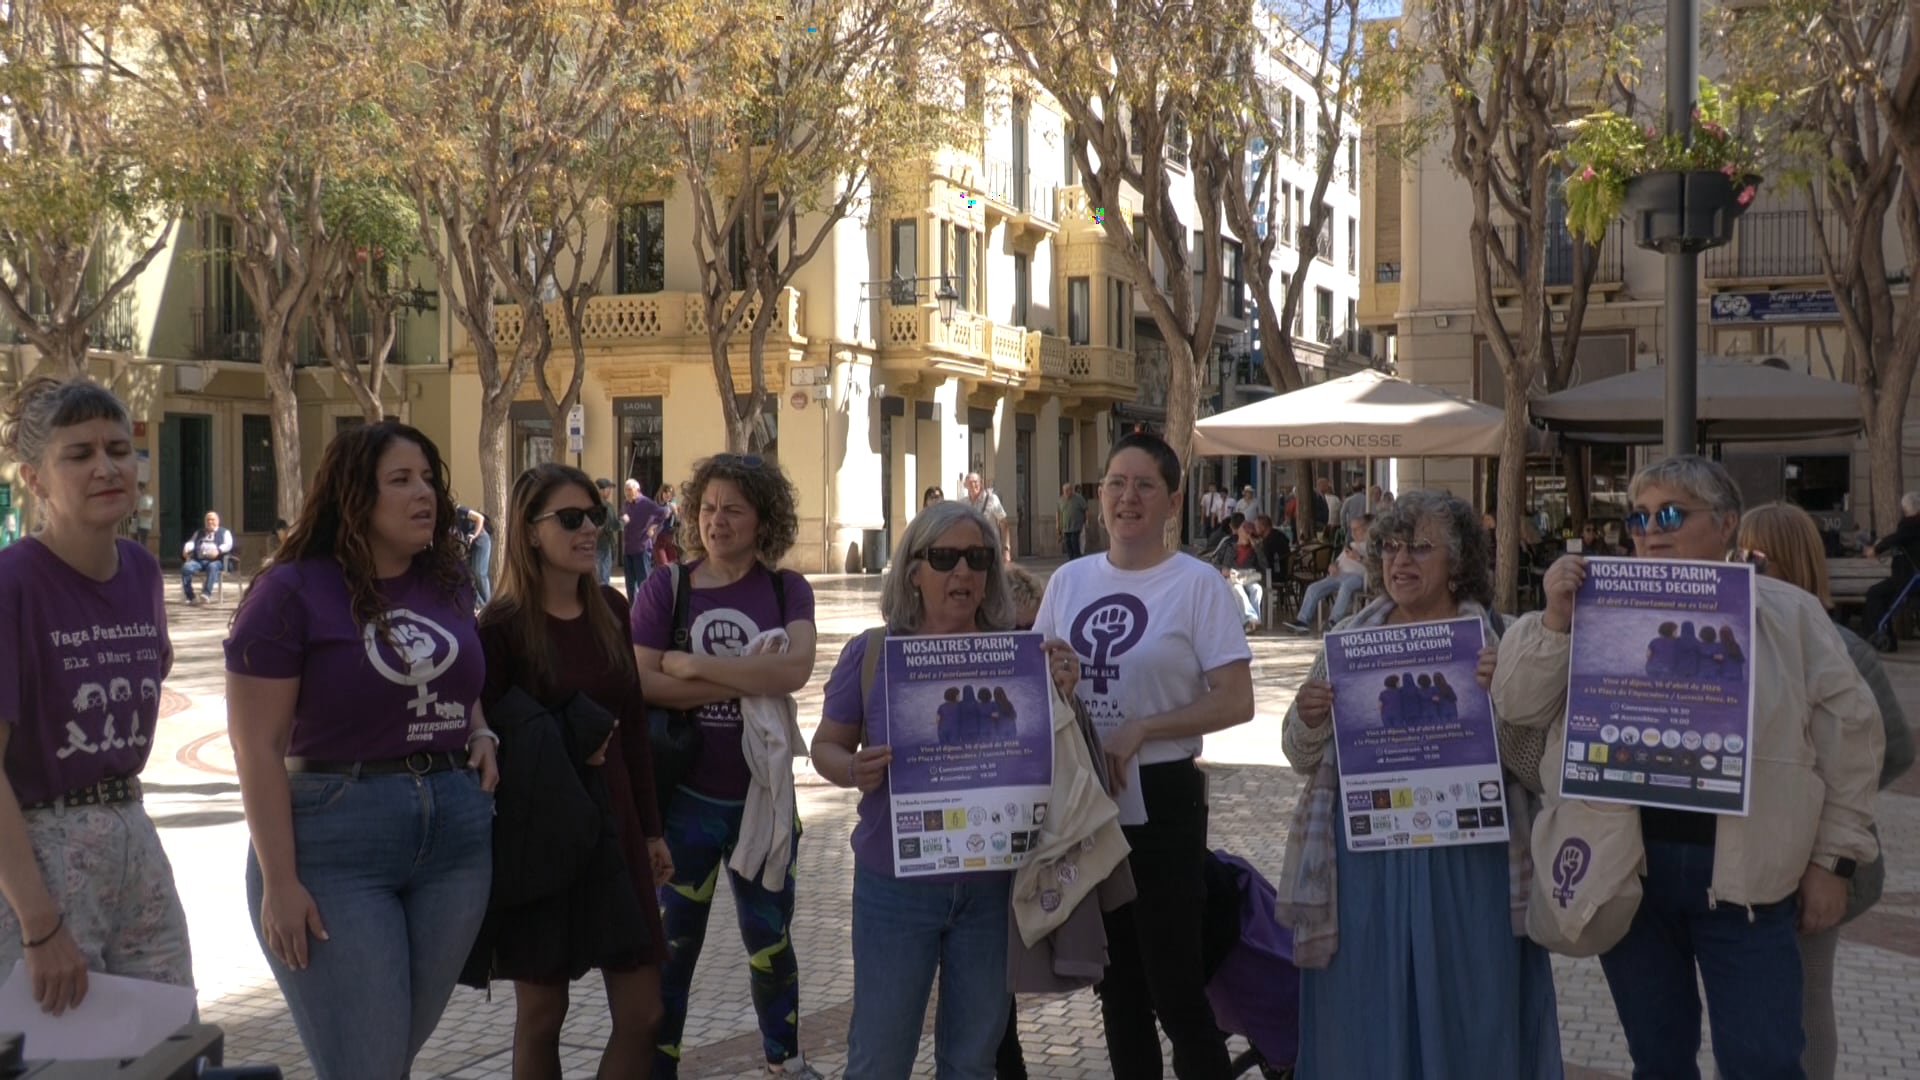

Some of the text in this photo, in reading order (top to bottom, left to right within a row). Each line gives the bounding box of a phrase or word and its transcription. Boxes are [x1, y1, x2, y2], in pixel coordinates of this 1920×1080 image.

[1278, 433, 1402, 448] BORGONESSE
[1591, 564, 1721, 584] NOSALTRES PARIM,
[1595, 580, 1716, 595] NOSALTRES DECIDIM
[50, 630, 90, 647] Vaga
[1340, 624, 1455, 646] NOSALTRES PARIM,
[903, 636, 1018, 654] NOSALTRES PARIM,
[1344, 638, 1452, 658] NOSALTRES DECIDIM
[64, 656, 90, 671] Elx
[906, 651, 1015, 668] NOSALTRES DECIDIM
[1101, 670, 1116, 678] ELX
[408, 720, 466, 732] INTERSINDICA
